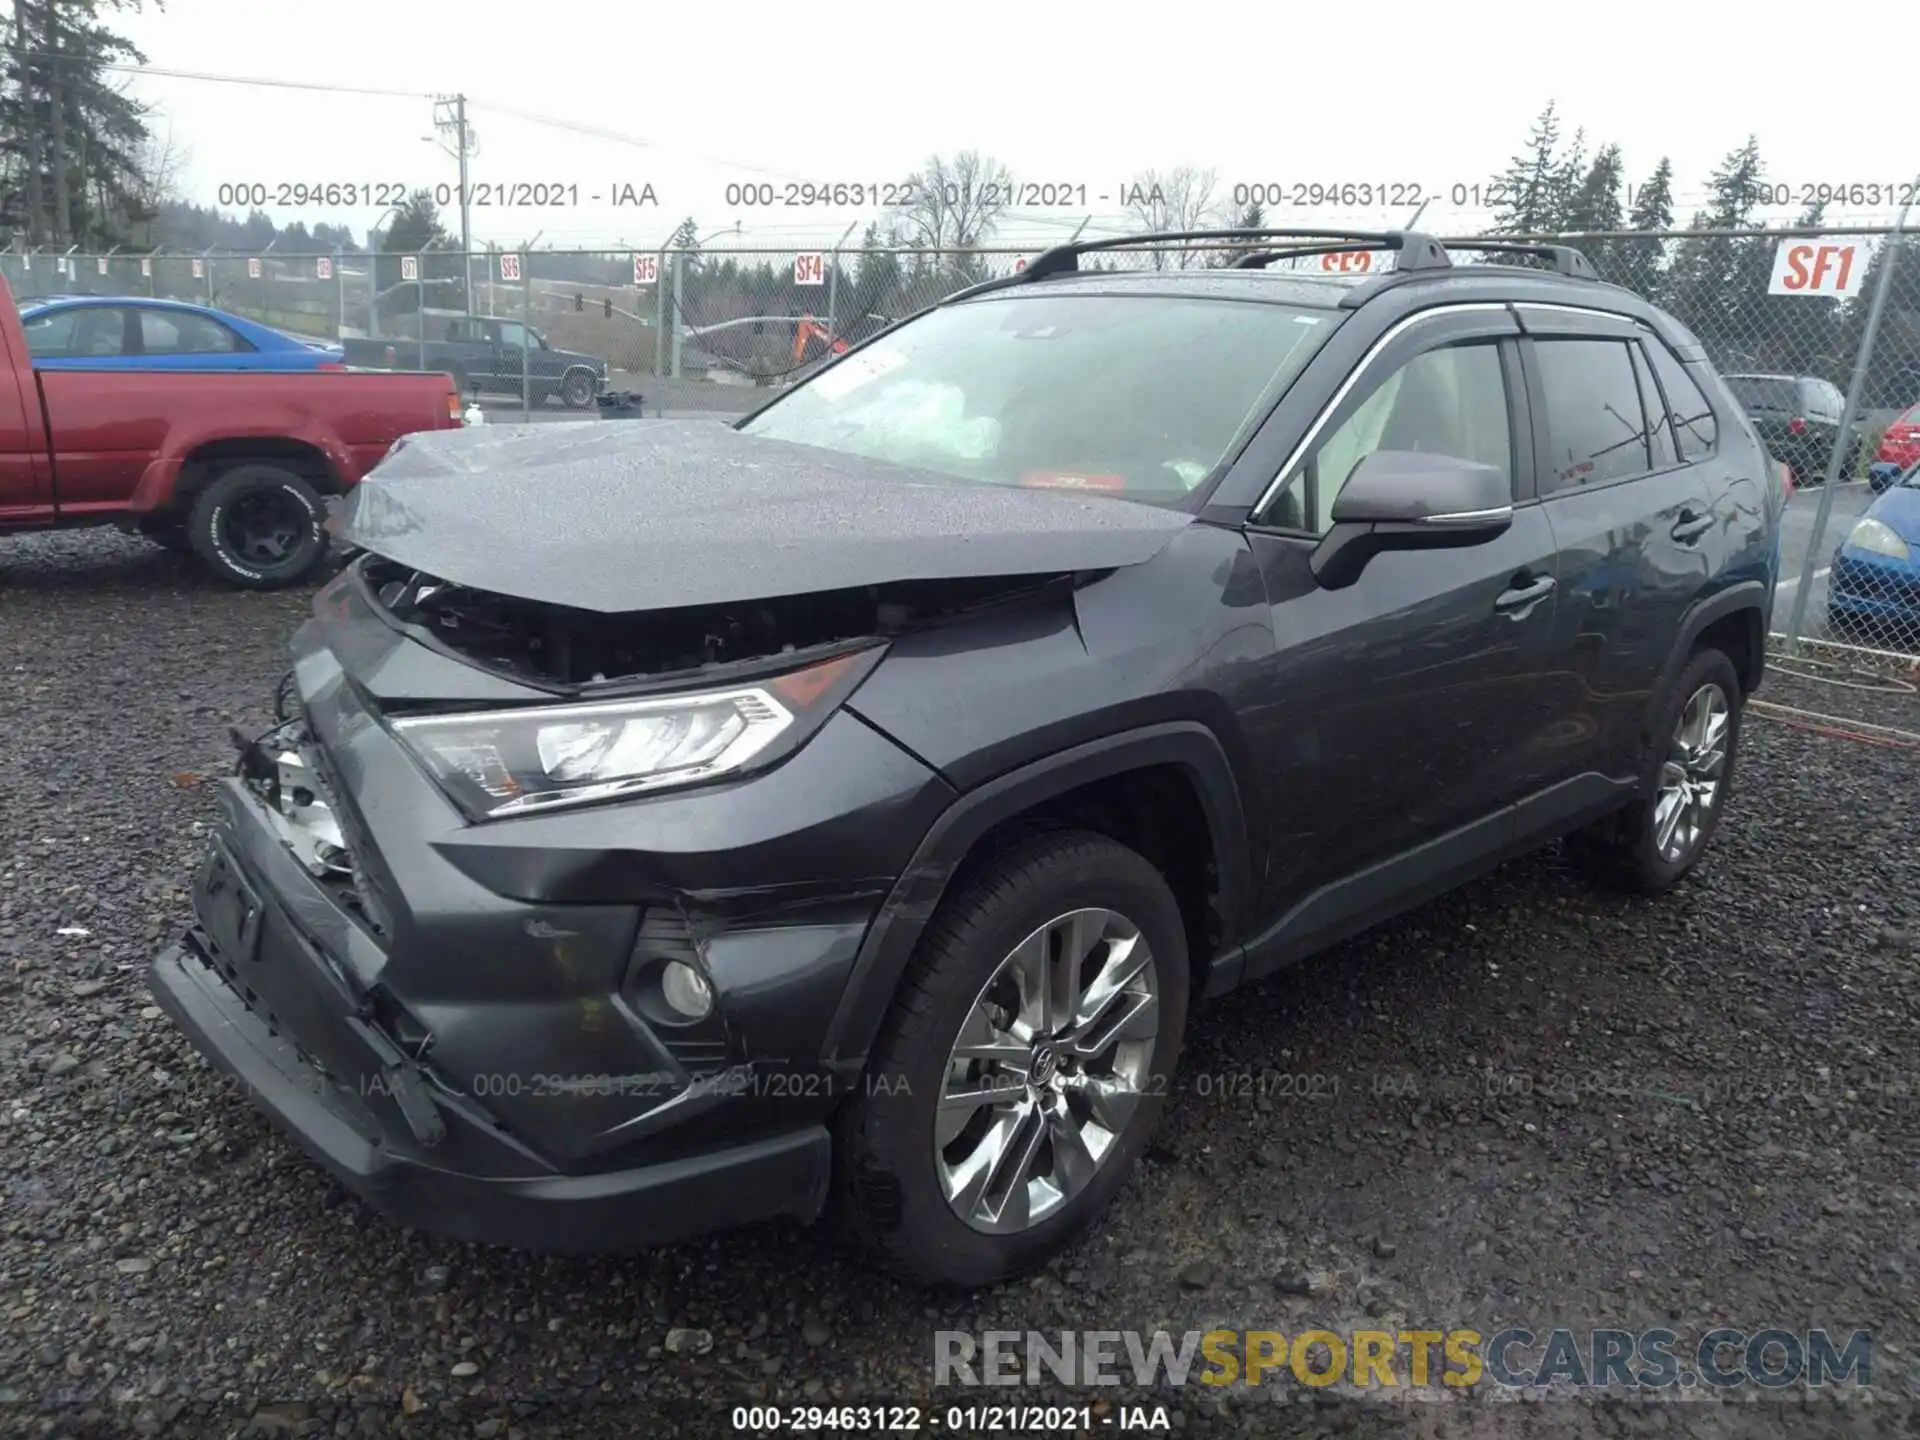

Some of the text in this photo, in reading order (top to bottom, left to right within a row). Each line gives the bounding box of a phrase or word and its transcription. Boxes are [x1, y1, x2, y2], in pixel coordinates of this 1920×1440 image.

[635, 256, 656, 281] SF5
[797, 255, 821, 281] SF4
[1783, 244, 1856, 291] SF1
